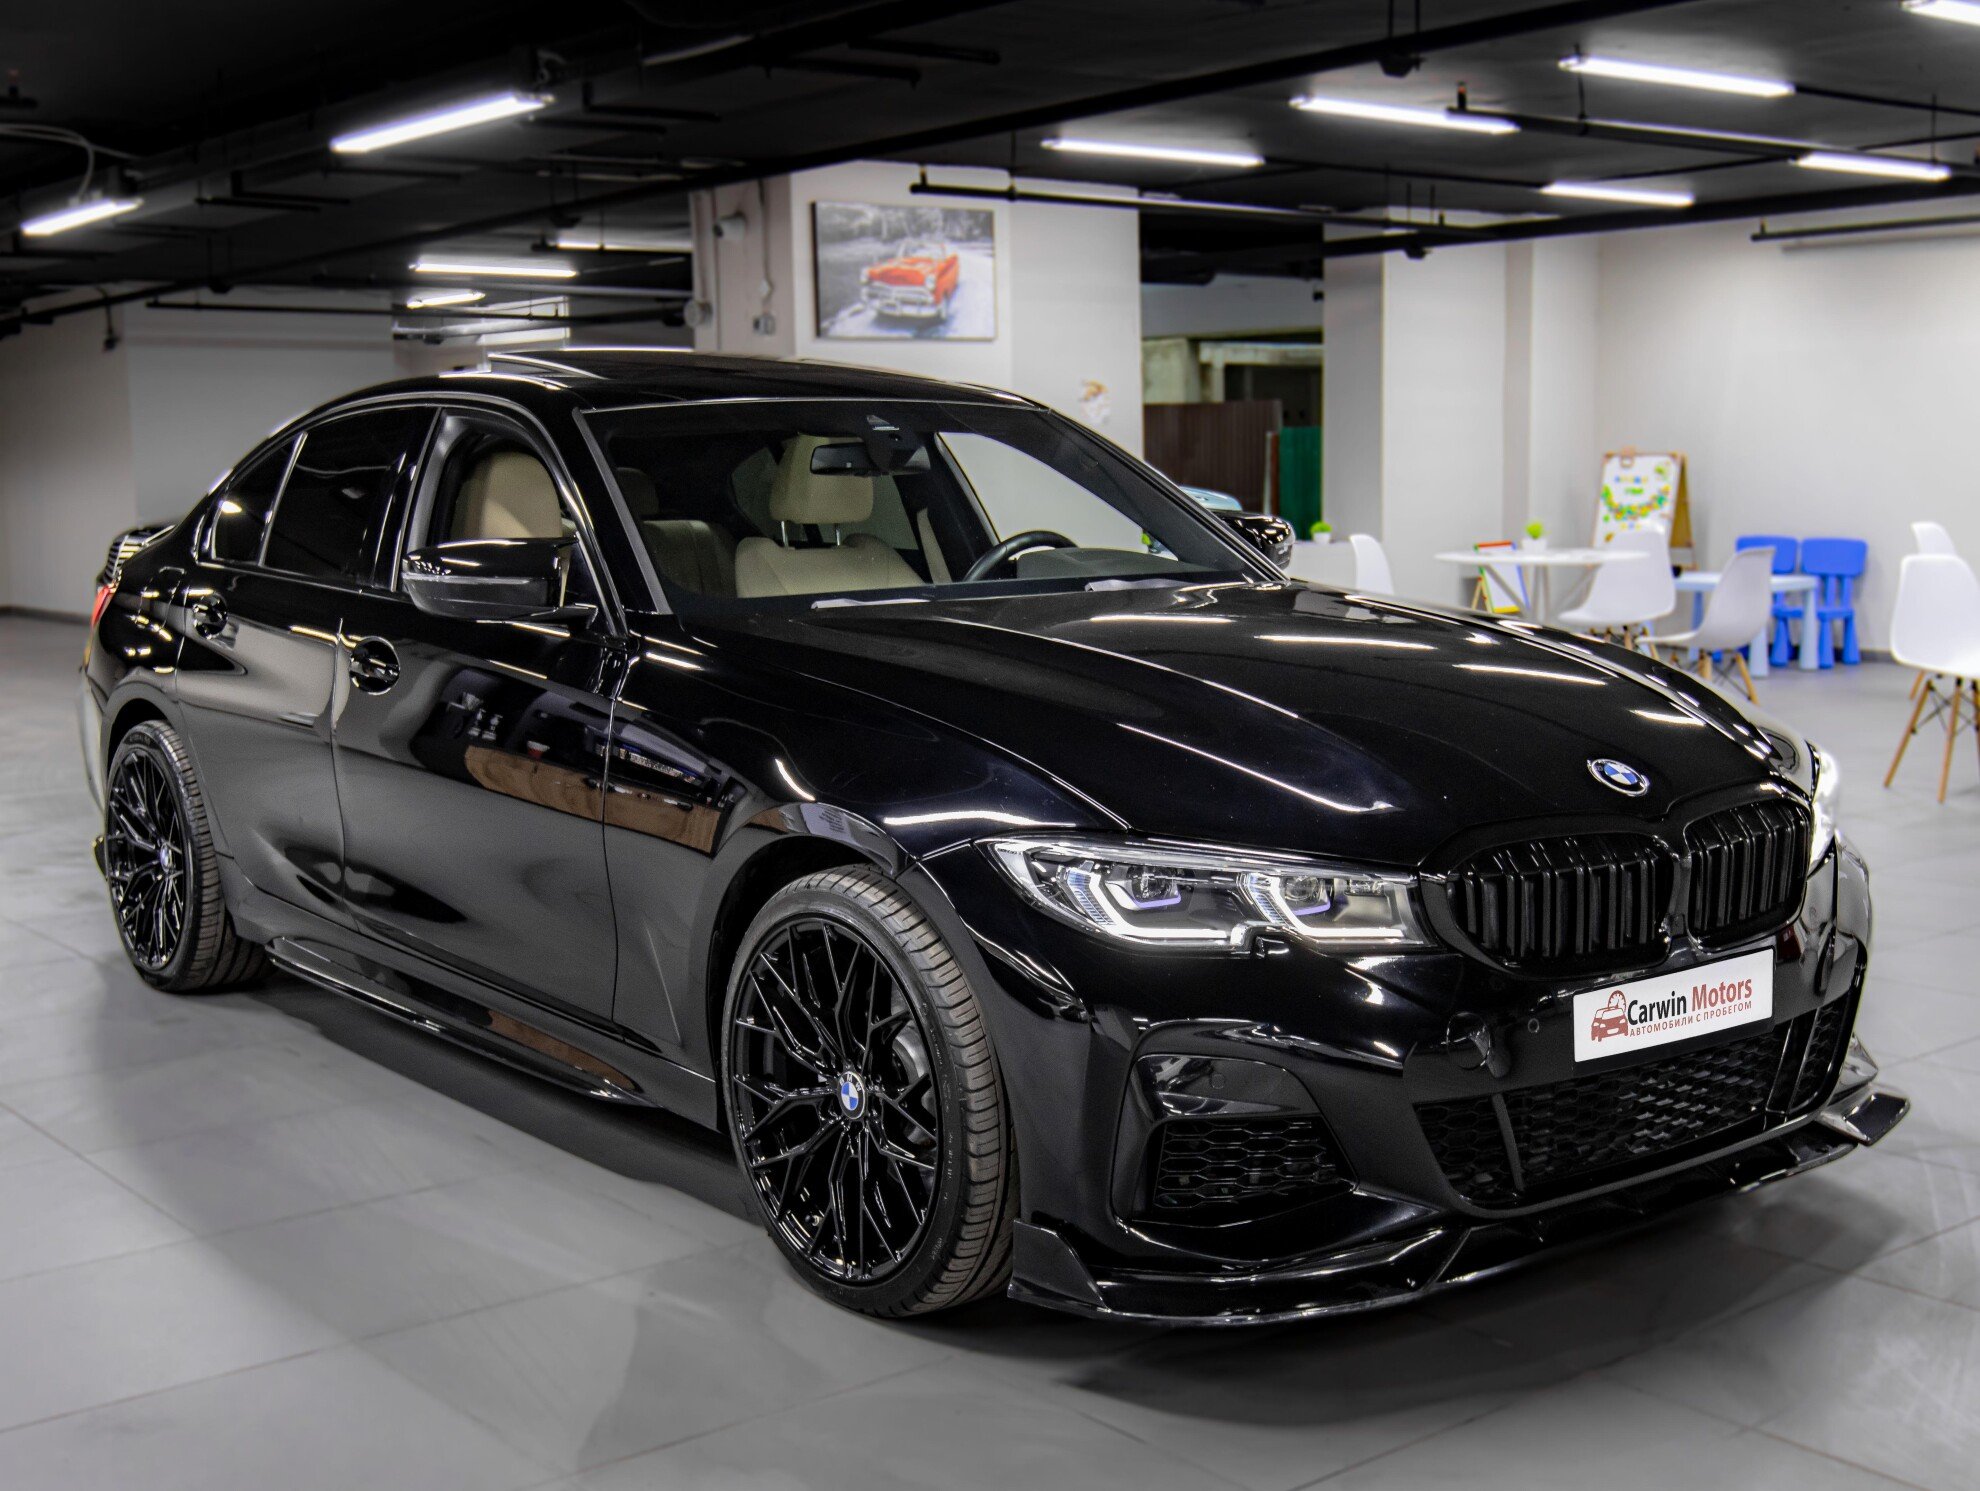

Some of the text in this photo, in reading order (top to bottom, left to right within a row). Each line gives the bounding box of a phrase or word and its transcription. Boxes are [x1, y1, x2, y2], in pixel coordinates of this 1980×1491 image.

[1627, 978, 1753, 1025] Carwin Motors
[1629, 1000, 1752, 1037] АВТОМОБИЛИ С ПРОБЕГОМ
